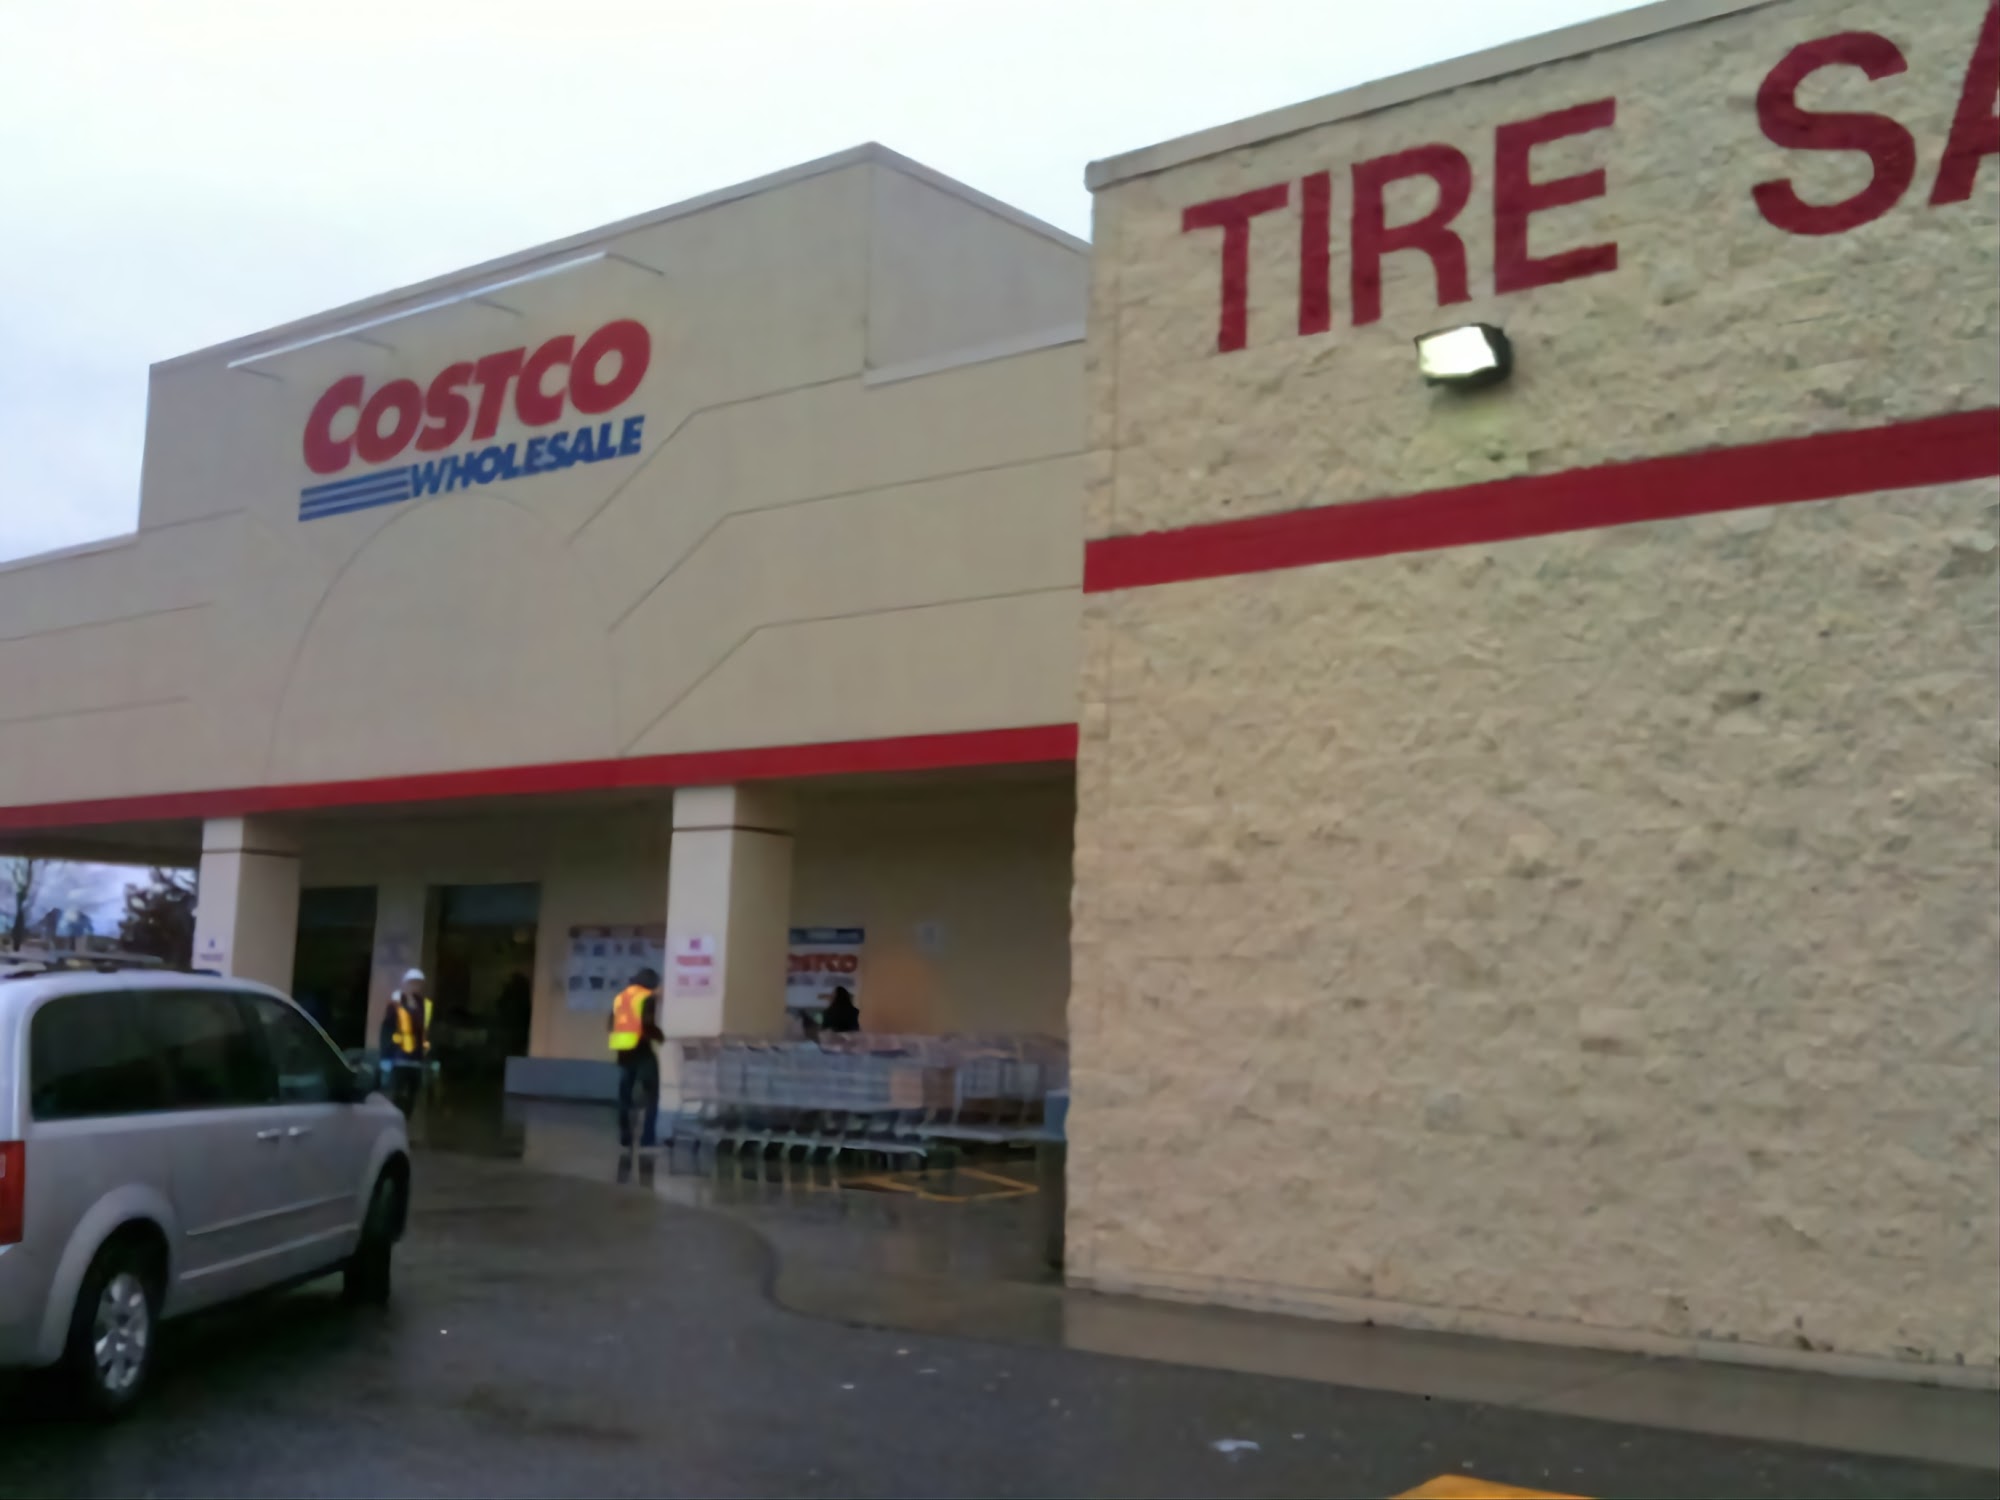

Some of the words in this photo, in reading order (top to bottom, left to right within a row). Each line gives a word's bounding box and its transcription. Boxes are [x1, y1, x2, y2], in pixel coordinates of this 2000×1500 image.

[1181, 98, 1618, 353] TIRE
[303, 319, 651, 474] COSTCO
[409, 414, 645, 498] WHOLESALE
